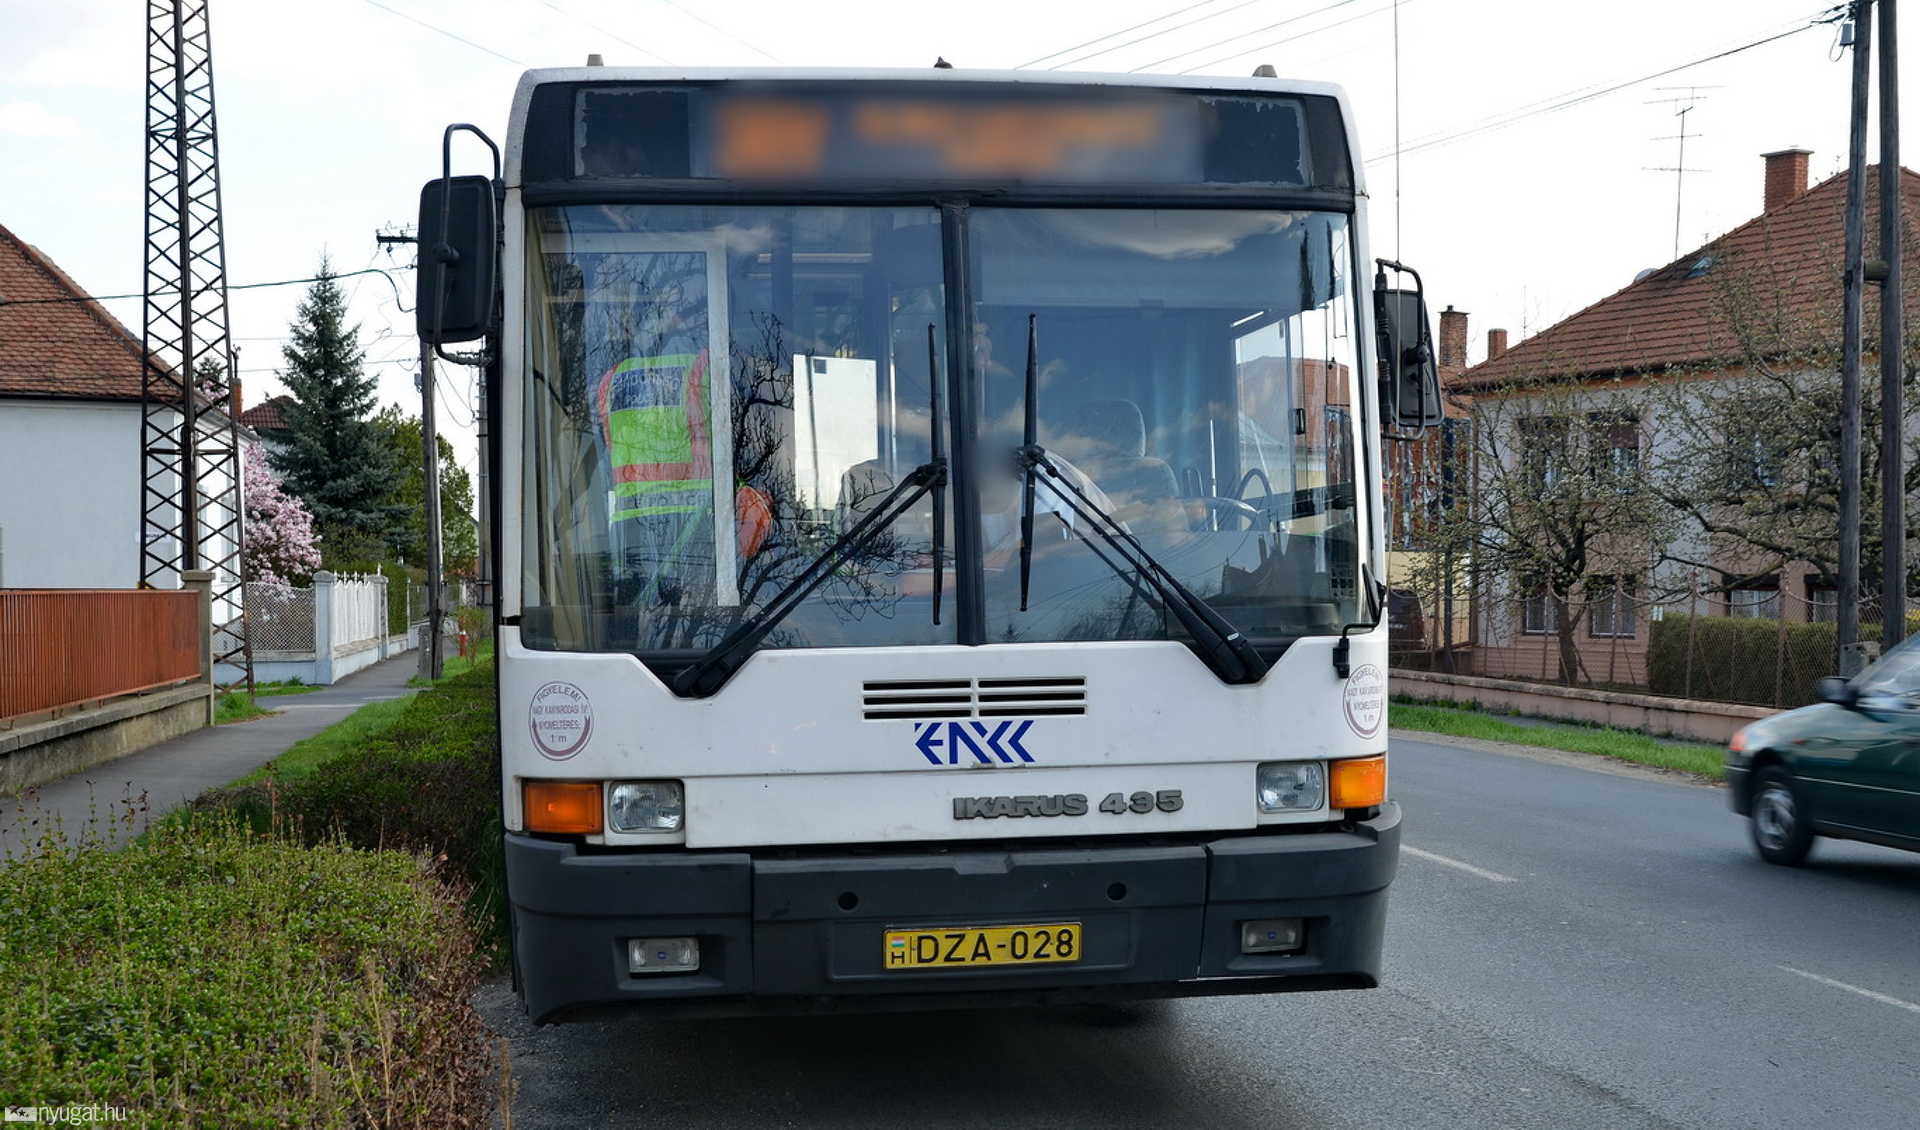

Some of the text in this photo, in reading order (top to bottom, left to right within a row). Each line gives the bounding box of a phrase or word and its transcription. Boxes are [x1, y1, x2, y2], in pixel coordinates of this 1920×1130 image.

[558, 735, 567, 743] m
[952, 790, 1185, 820] IKARUS 435
[891, 929, 1074, 965] H DZA-028
